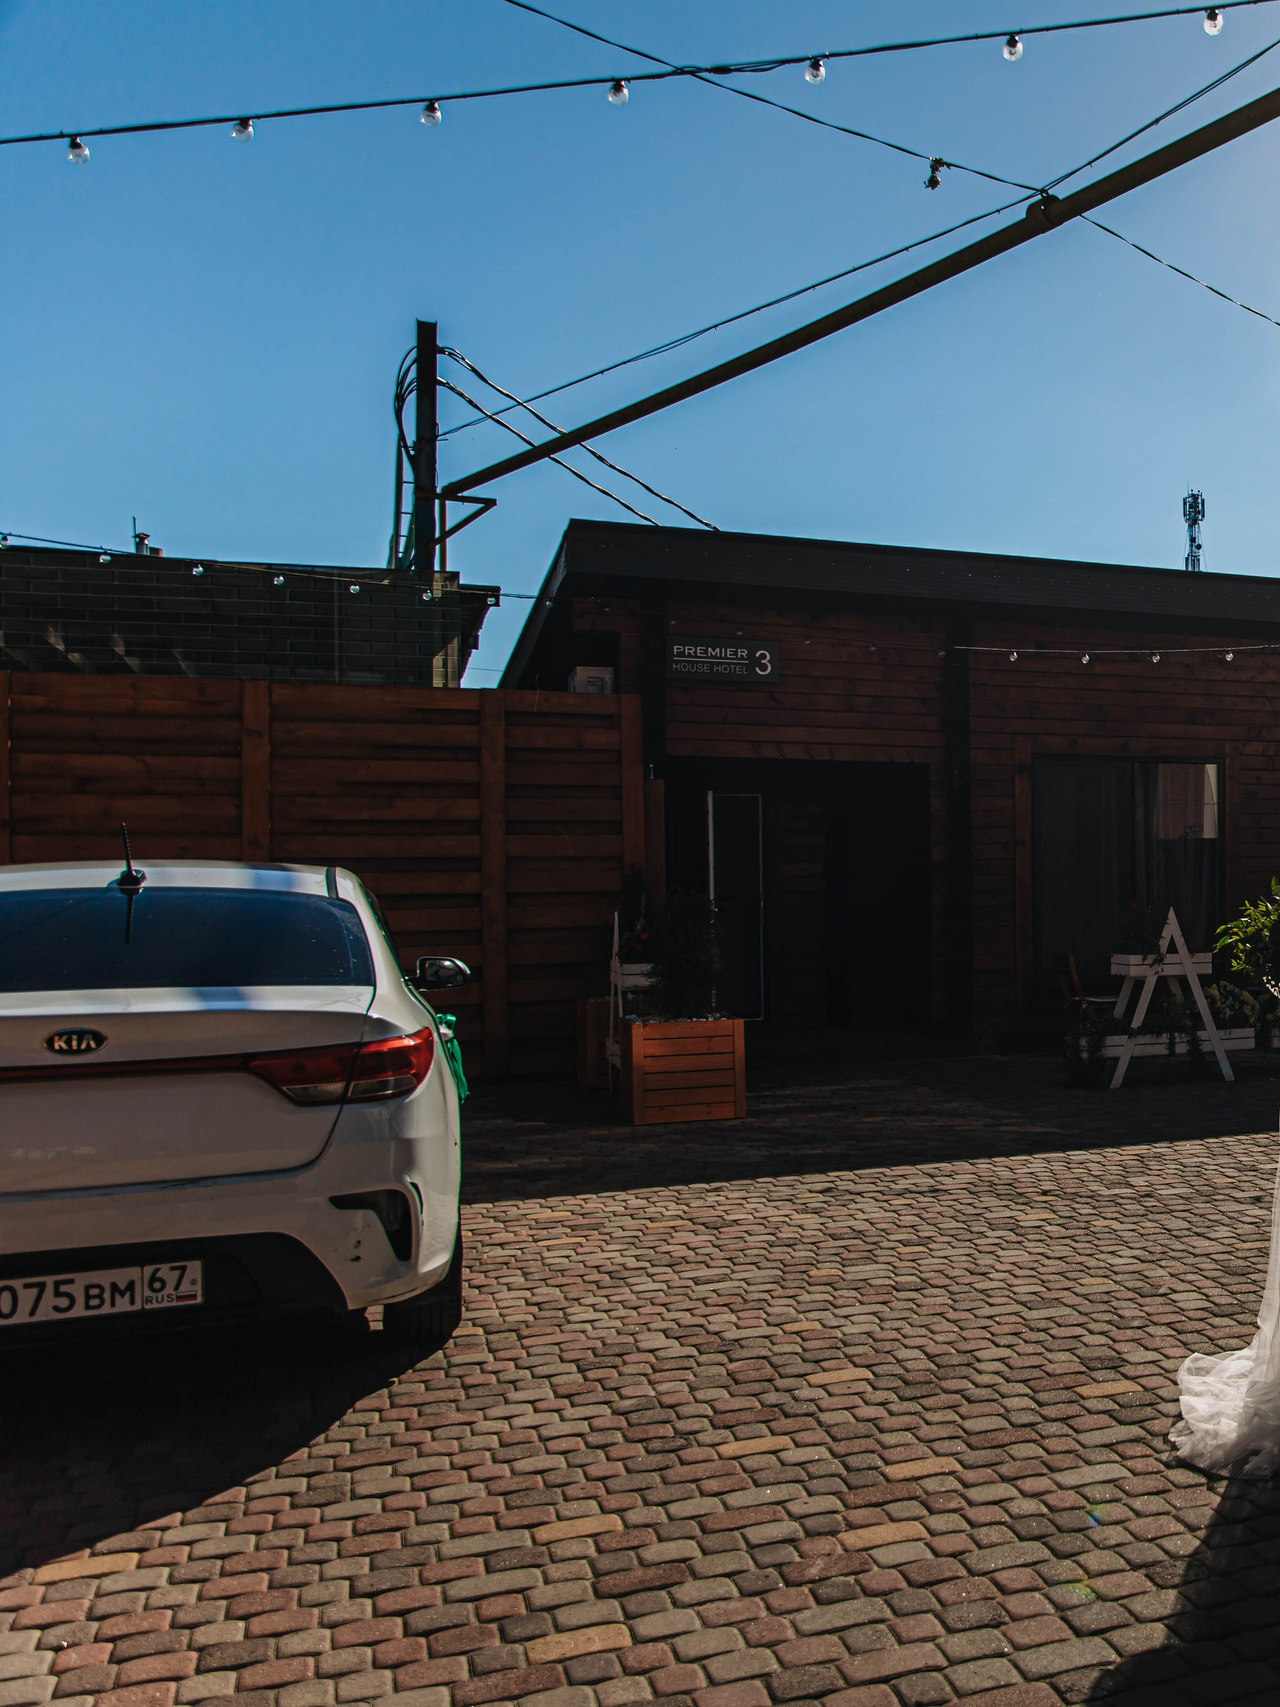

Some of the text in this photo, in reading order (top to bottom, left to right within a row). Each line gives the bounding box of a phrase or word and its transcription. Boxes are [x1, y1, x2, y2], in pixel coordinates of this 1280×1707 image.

[673, 645, 748, 658] PREMIER
[672, 662, 748, 675] HOUSE HOTEL
[755, 650, 772, 675] 3
[53, 1034, 98, 1051] KIA
[148, 1265, 188, 1294] 67
[145, 1293, 175, 1305] RUS
